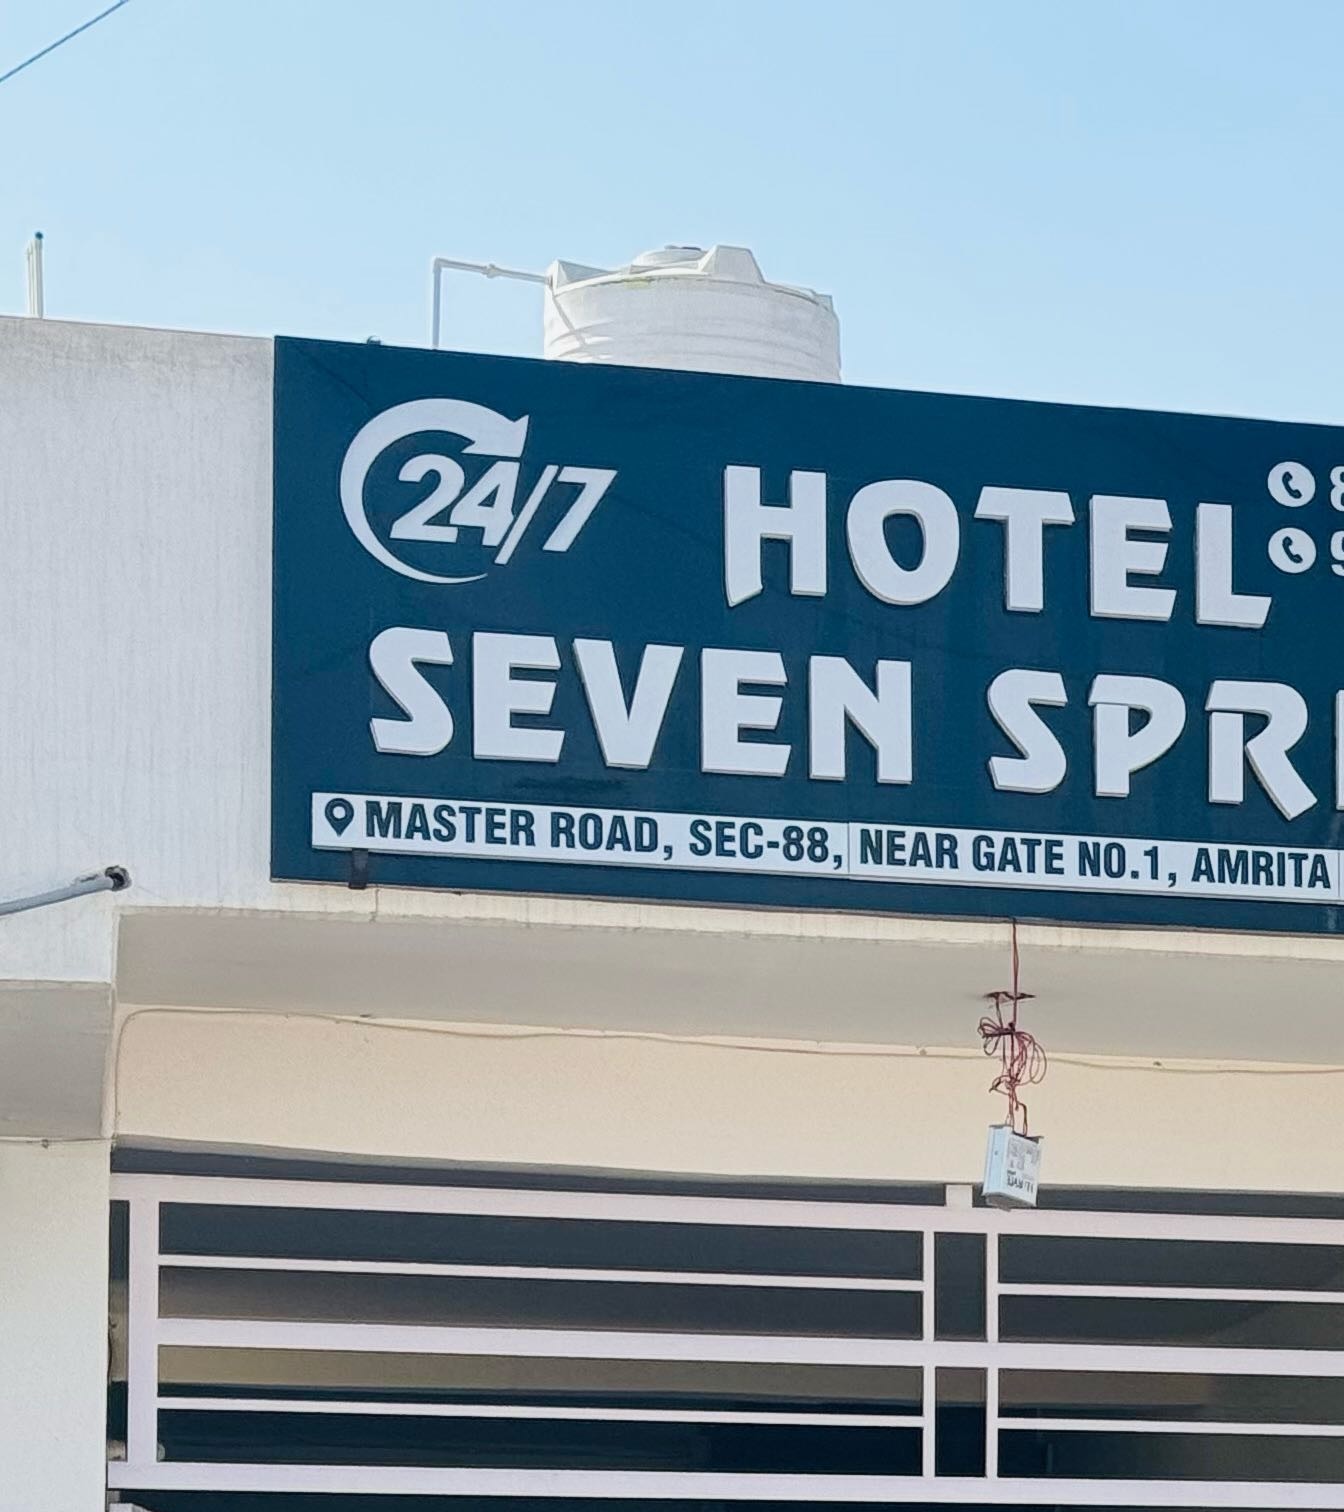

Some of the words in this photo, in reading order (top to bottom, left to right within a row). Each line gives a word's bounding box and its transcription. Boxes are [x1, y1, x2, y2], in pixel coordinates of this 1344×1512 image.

[389, 452, 619, 566] 24/7
[724, 464, 1272, 628] HOTEL
[369, 626, 912, 785] SEVEN
[365, 799, 536, 847] MASTER
[551, 812, 674, 861] ROAD,
[688, 819, 844, 870] SEC-88,
[859, 828, 959, 870] NEAR
[972, 834, 1066, 876] GATE
[1078, 841, 1178, 888] NO.1,
[1191, 847, 1331, 889] AMRITA
